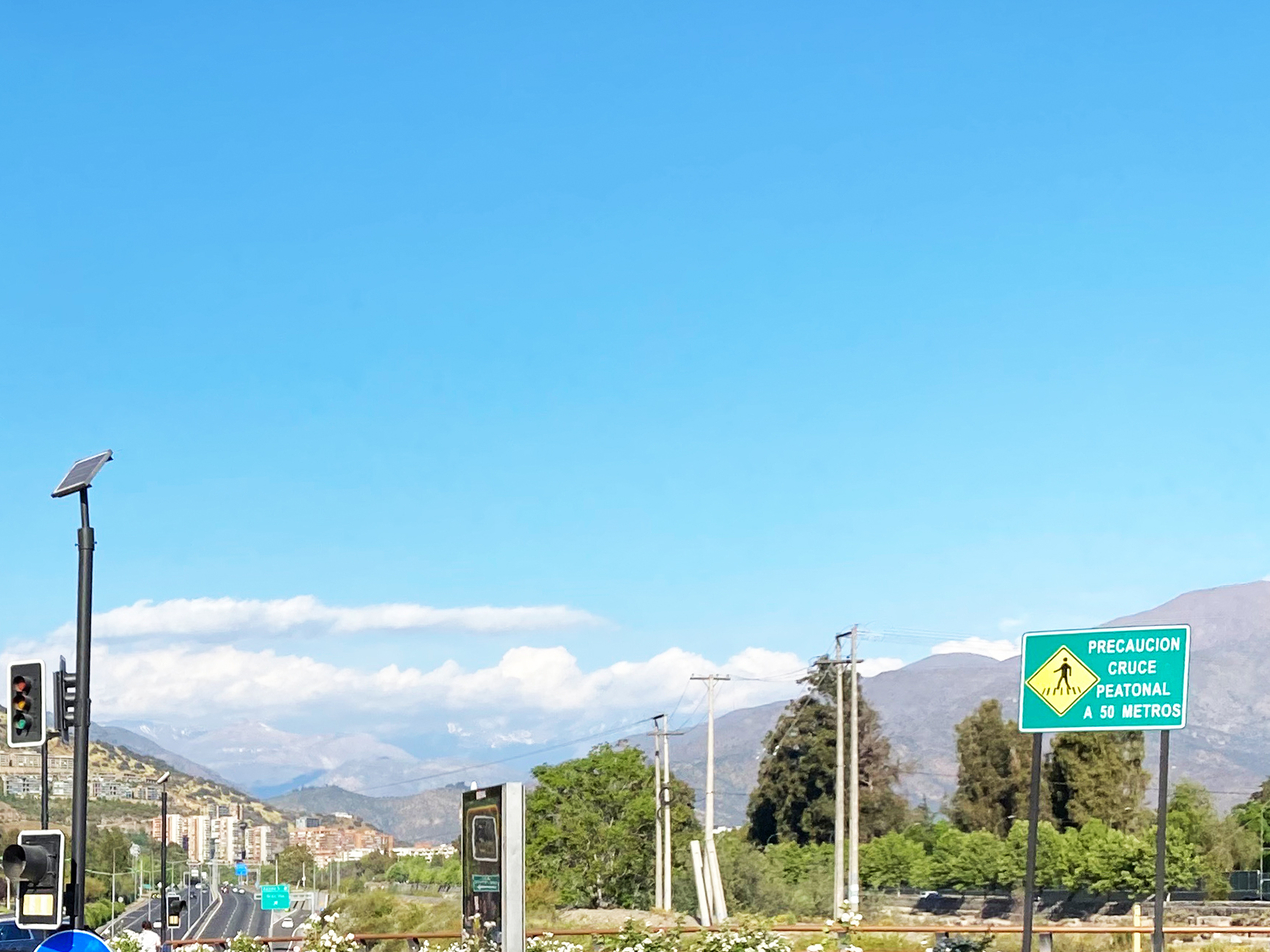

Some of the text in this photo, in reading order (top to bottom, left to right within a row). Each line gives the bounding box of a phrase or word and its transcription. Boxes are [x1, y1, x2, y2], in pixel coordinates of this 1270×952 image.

[1088, 637, 1180, 654] PRECAUCION
[1108, 660, 1157, 675] CRUCE
[1096, 682, 1171, 698] PEATONAL
[1083, 703, 1181, 719] A 50 METROS
